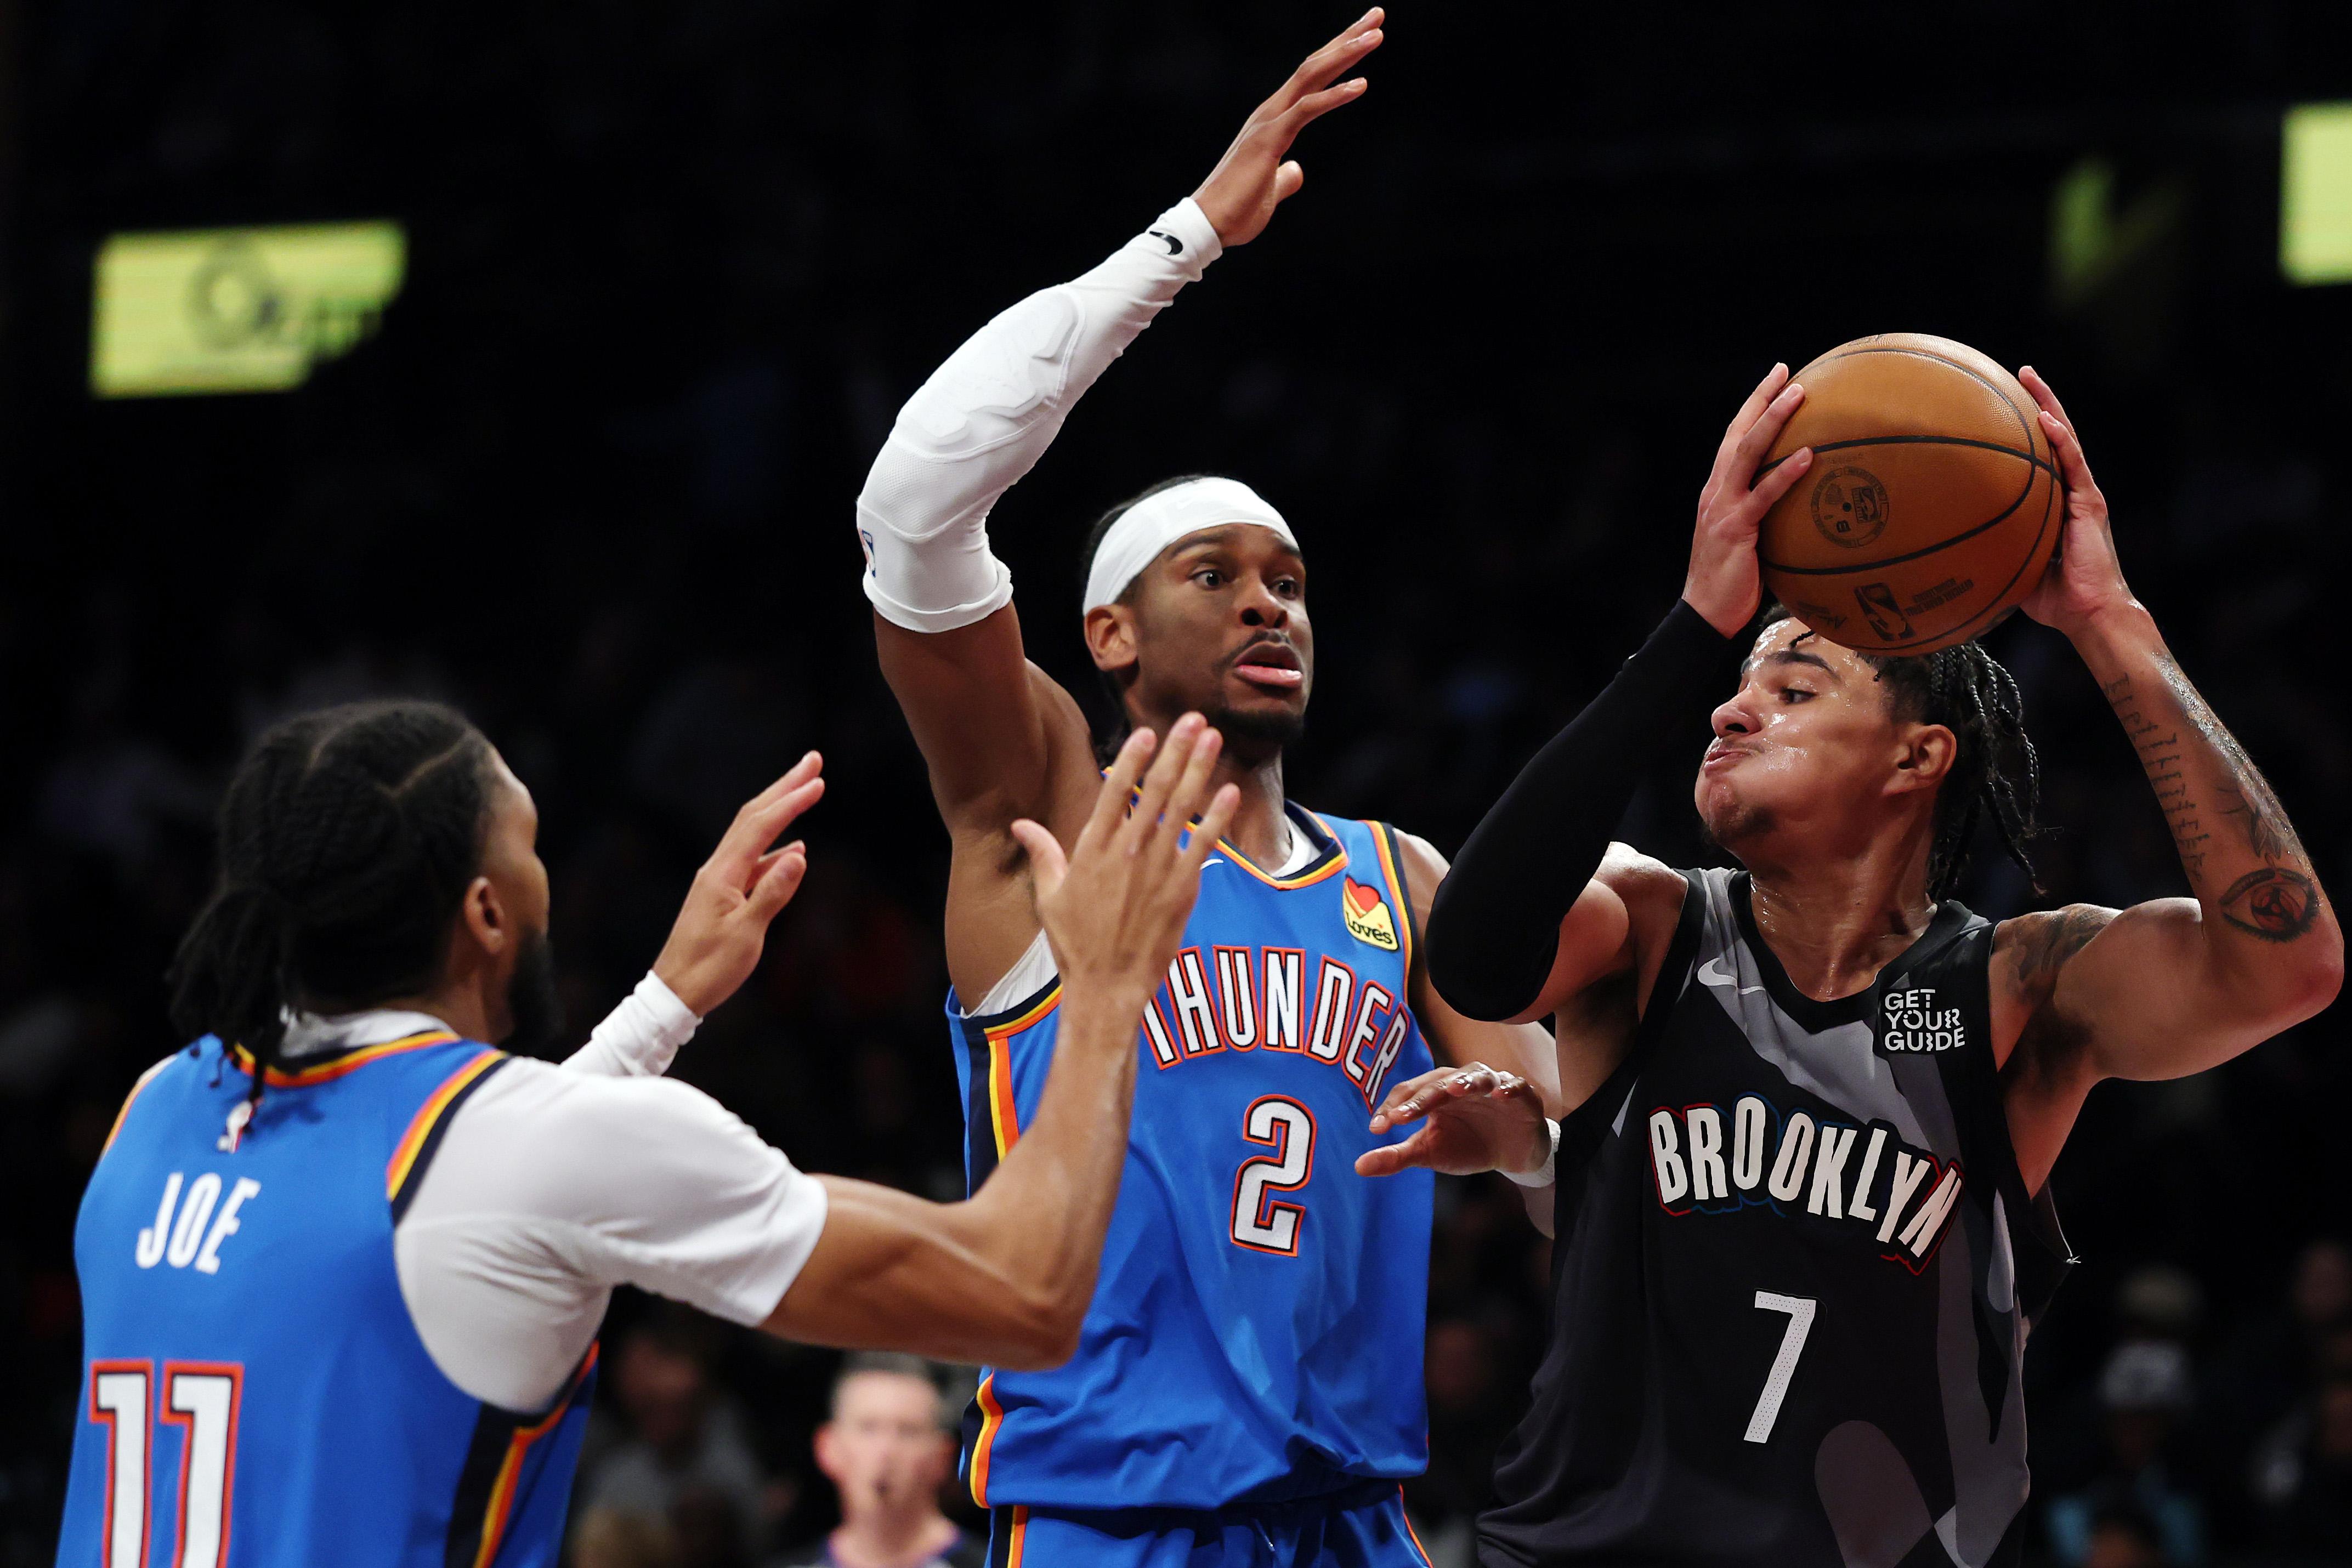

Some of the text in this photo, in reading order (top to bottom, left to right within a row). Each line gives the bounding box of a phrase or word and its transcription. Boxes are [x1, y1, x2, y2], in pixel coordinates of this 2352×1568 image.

[1884, 988, 1936, 1010] GET
[1884, 1008, 1961, 1031] YOUR
[1884, 1026, 1965, 1052] GUIDE
[135, 1171, 262, 1275] JOE
[1229, 1093, 1318, 1258] 2
[1648, 1094, 1964, 1262] BROOKLYN
[1743, 1289, 1817, 1444] 7
[89, 1357, 245, 1567] 11
